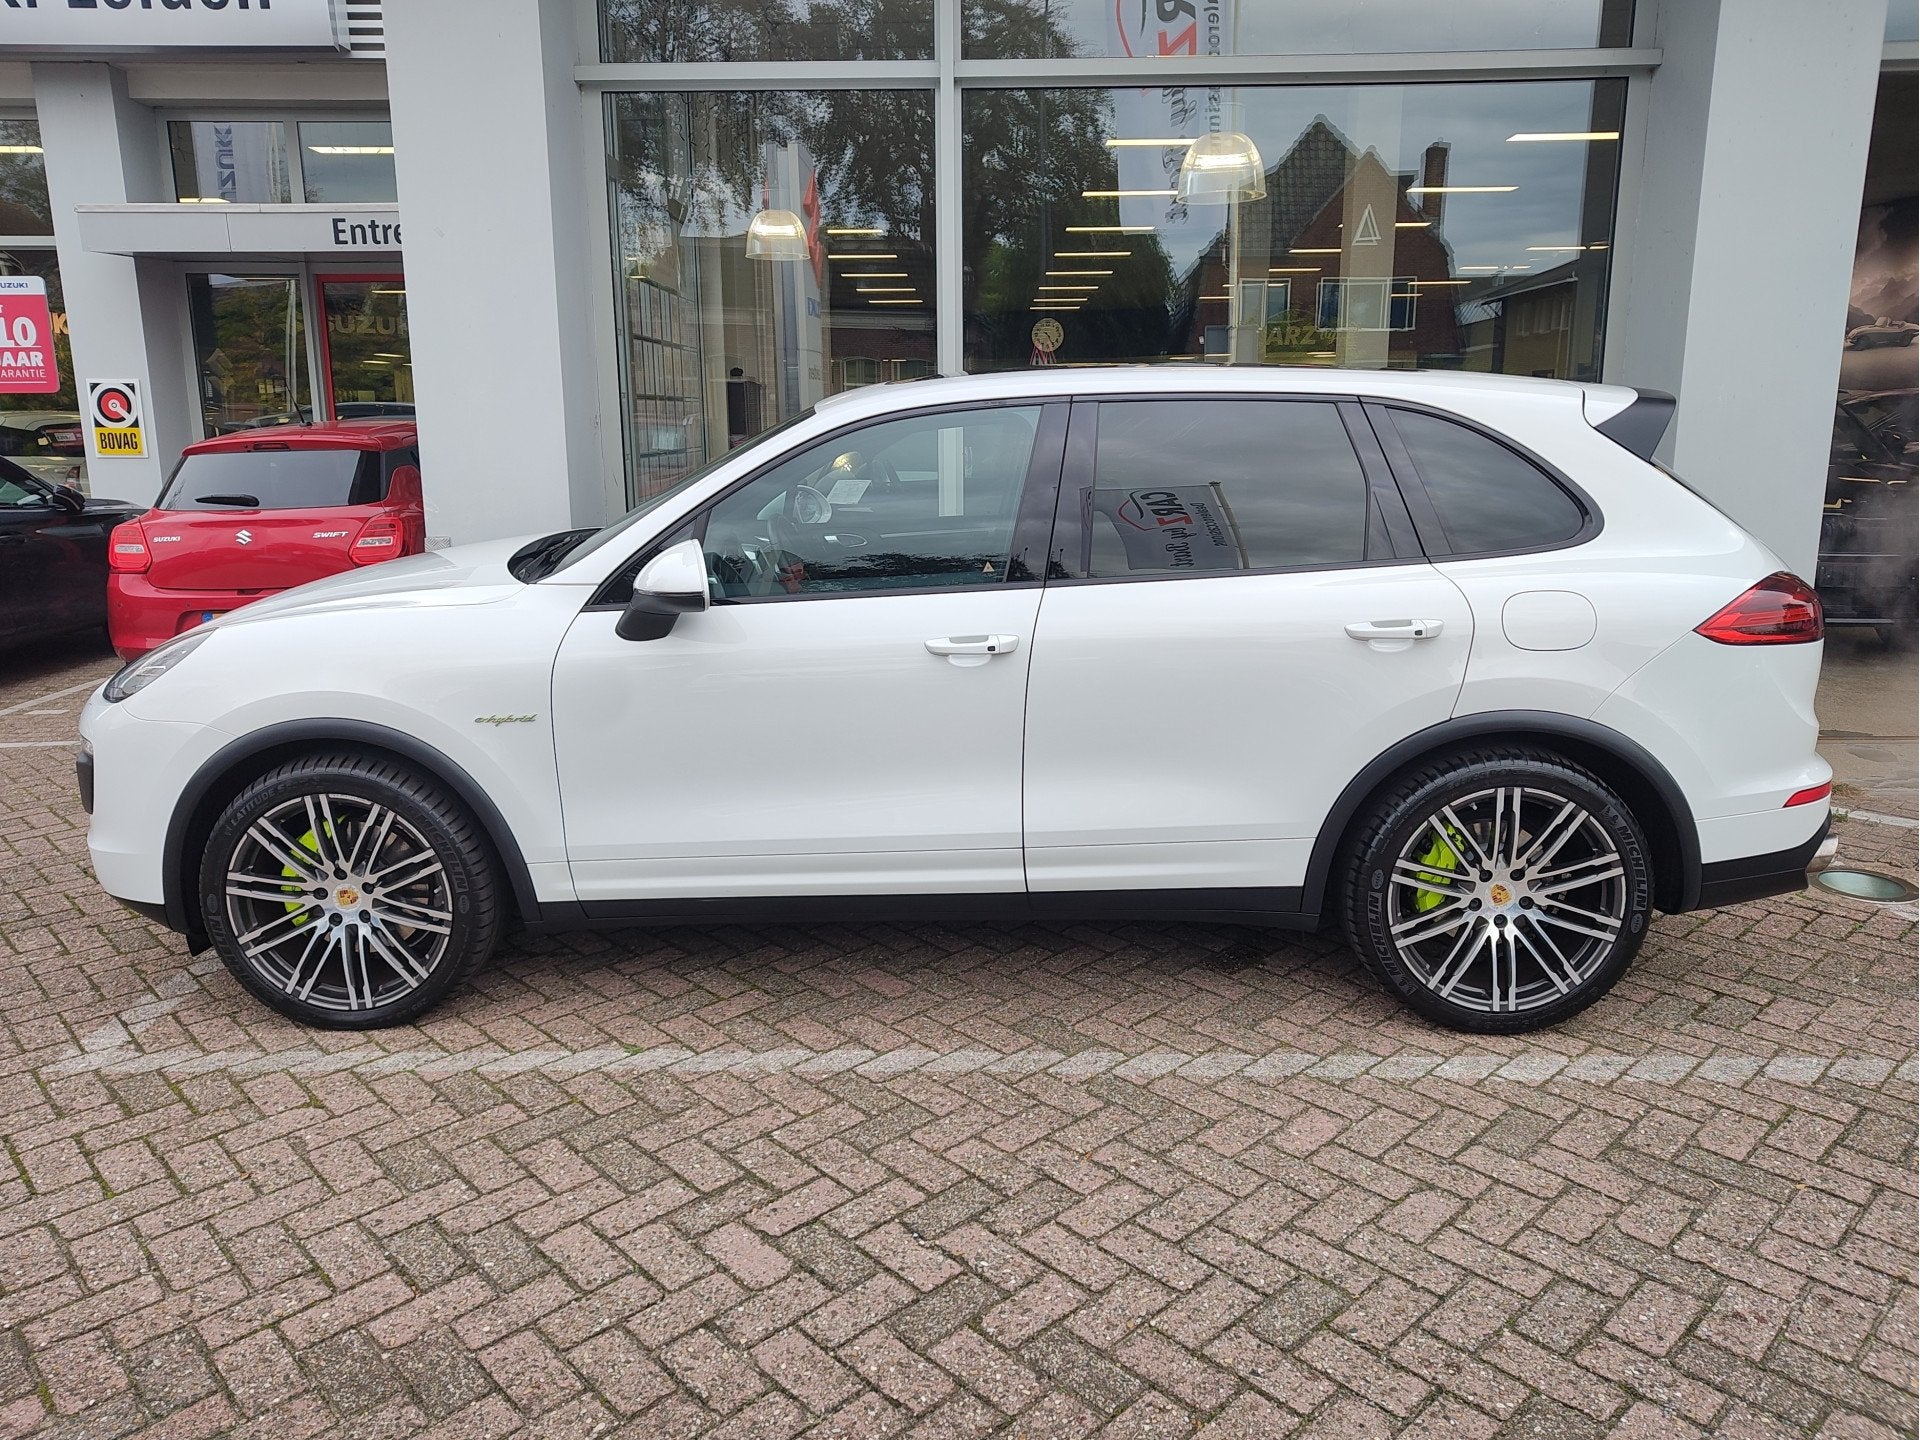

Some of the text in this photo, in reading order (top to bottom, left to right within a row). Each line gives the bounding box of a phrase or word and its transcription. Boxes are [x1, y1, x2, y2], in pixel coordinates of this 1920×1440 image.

[0, 351, 44, 367] AAR
[100, 432, 138, 450] BOVAG
[1617, 825, 1647, 908] MICHELIN
